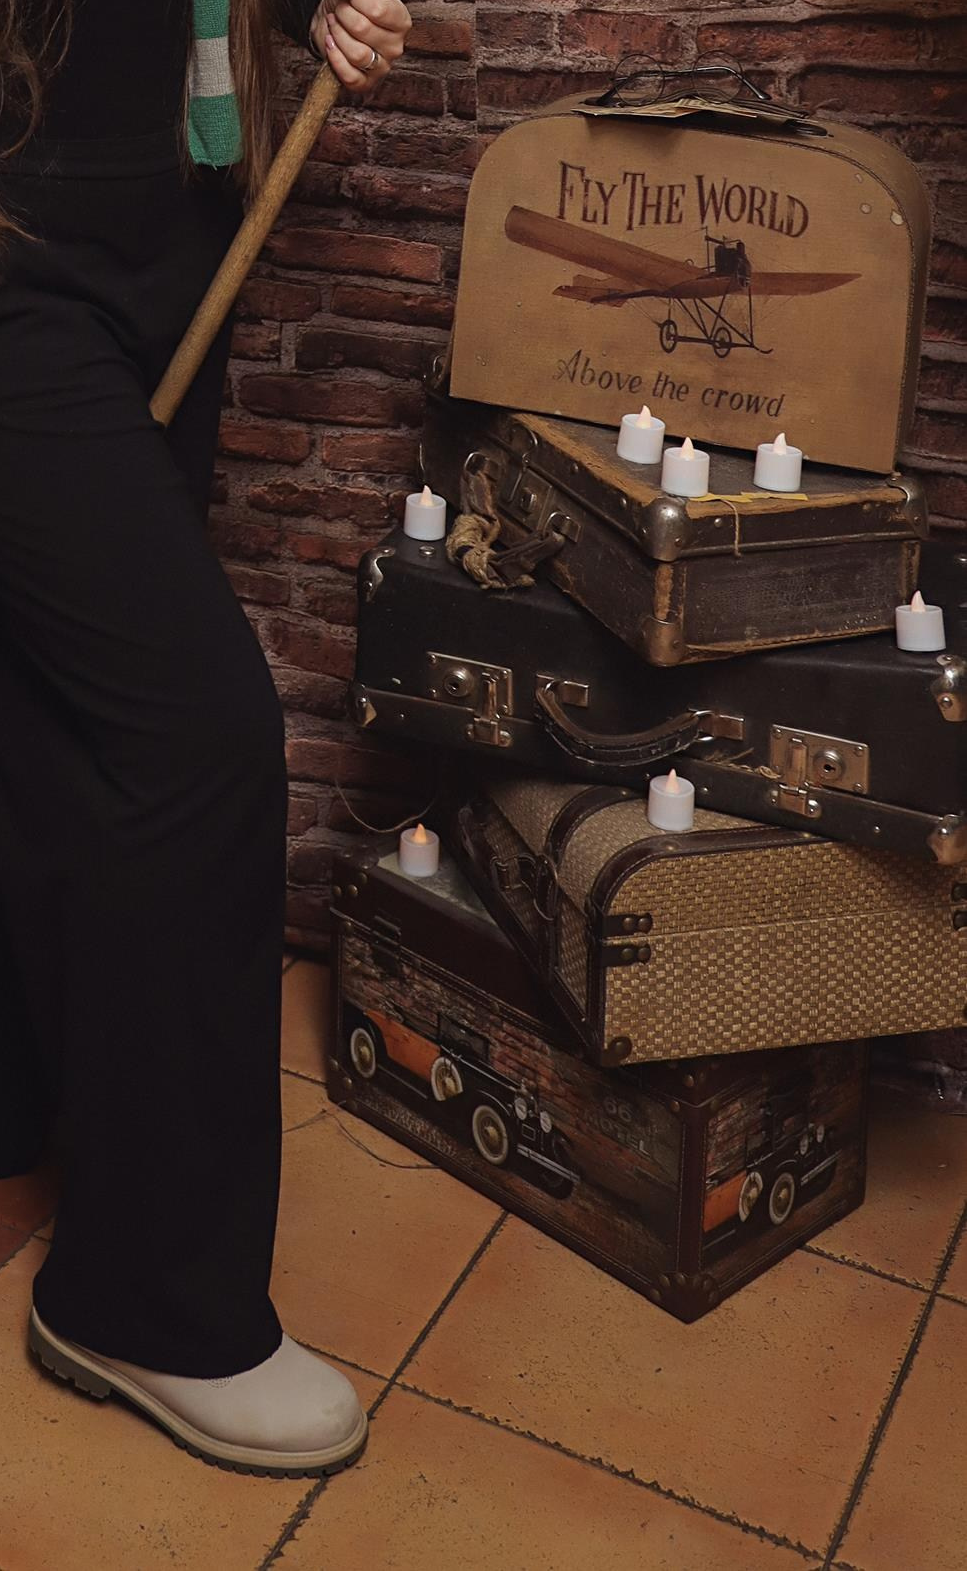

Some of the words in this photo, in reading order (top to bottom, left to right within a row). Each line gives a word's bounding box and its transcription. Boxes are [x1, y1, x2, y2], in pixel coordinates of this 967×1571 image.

[557, 161, 618, 223] FLY
[622, 172, 686, 231] THE
[695, 174, 811, 238] WORLD
[552, 349, 642, 398] Above
[653, 371, 690, 403] the
[701, 387, 787, 418] crowd
